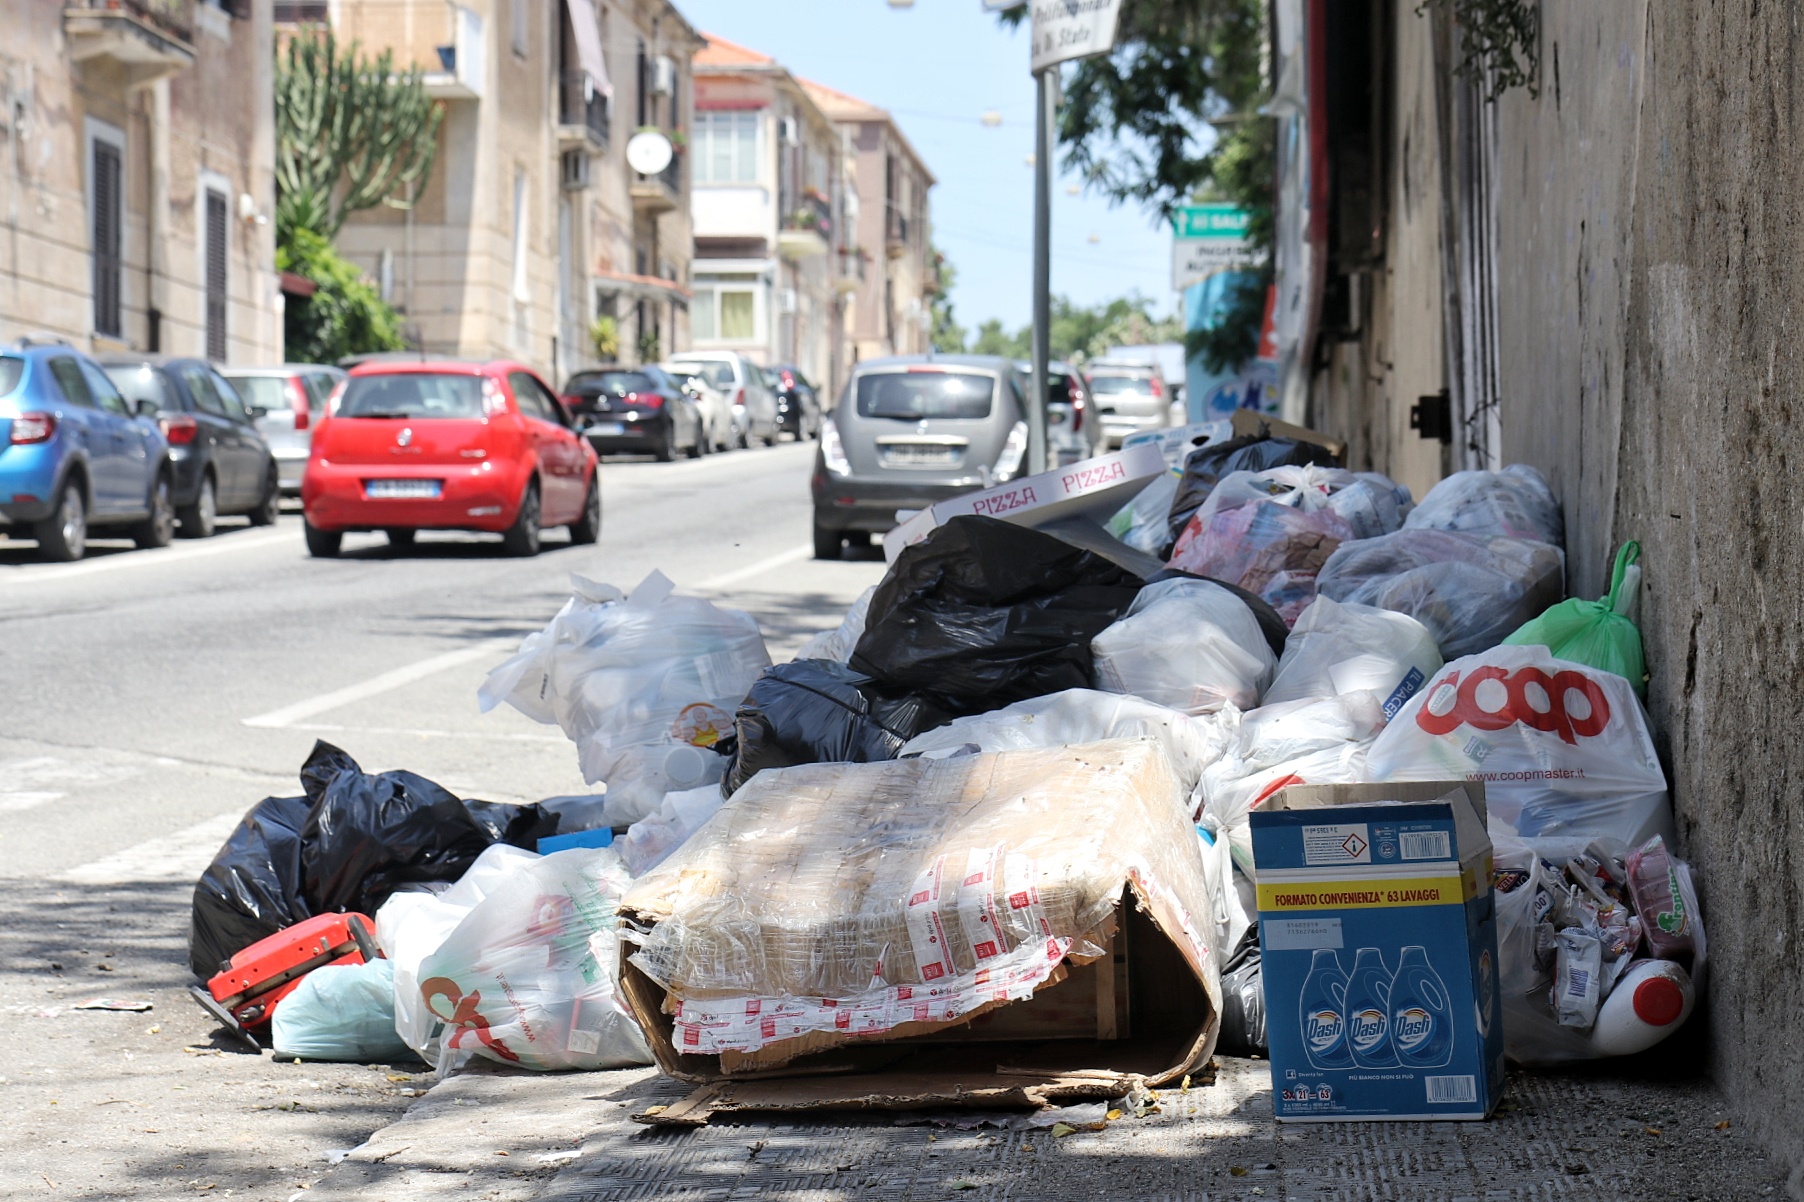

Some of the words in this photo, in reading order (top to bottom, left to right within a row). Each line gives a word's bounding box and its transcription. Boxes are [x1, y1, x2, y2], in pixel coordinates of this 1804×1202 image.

[1062, 461, 1126, 493] PIZZA
[973, 486, 1037, 515] PIZZA
[1410, 671, 1421, 681] IL
[1384, 681, 1414, 721] PIACER
[1416, 665, 1611, 747] coop
[1465, 767, 1586, 783] www.coopmaster.it
[1275, 893, 1317, 906] FORMATO
[1387, 891, 1399, 903] 63
[1400, 889, 1440, 902] LAVAGGI
[1307, 1017, 1341, 1039] Dash
[1350, 1016, 1385, 1038] Dash
[1395, 1014, 1430, 1037] Dash
[1282, 1089, 1296, 1101] 3x
[1298, 1090, 1306, 1100] 21
[1320, 1090, 1329, 1099] 63
